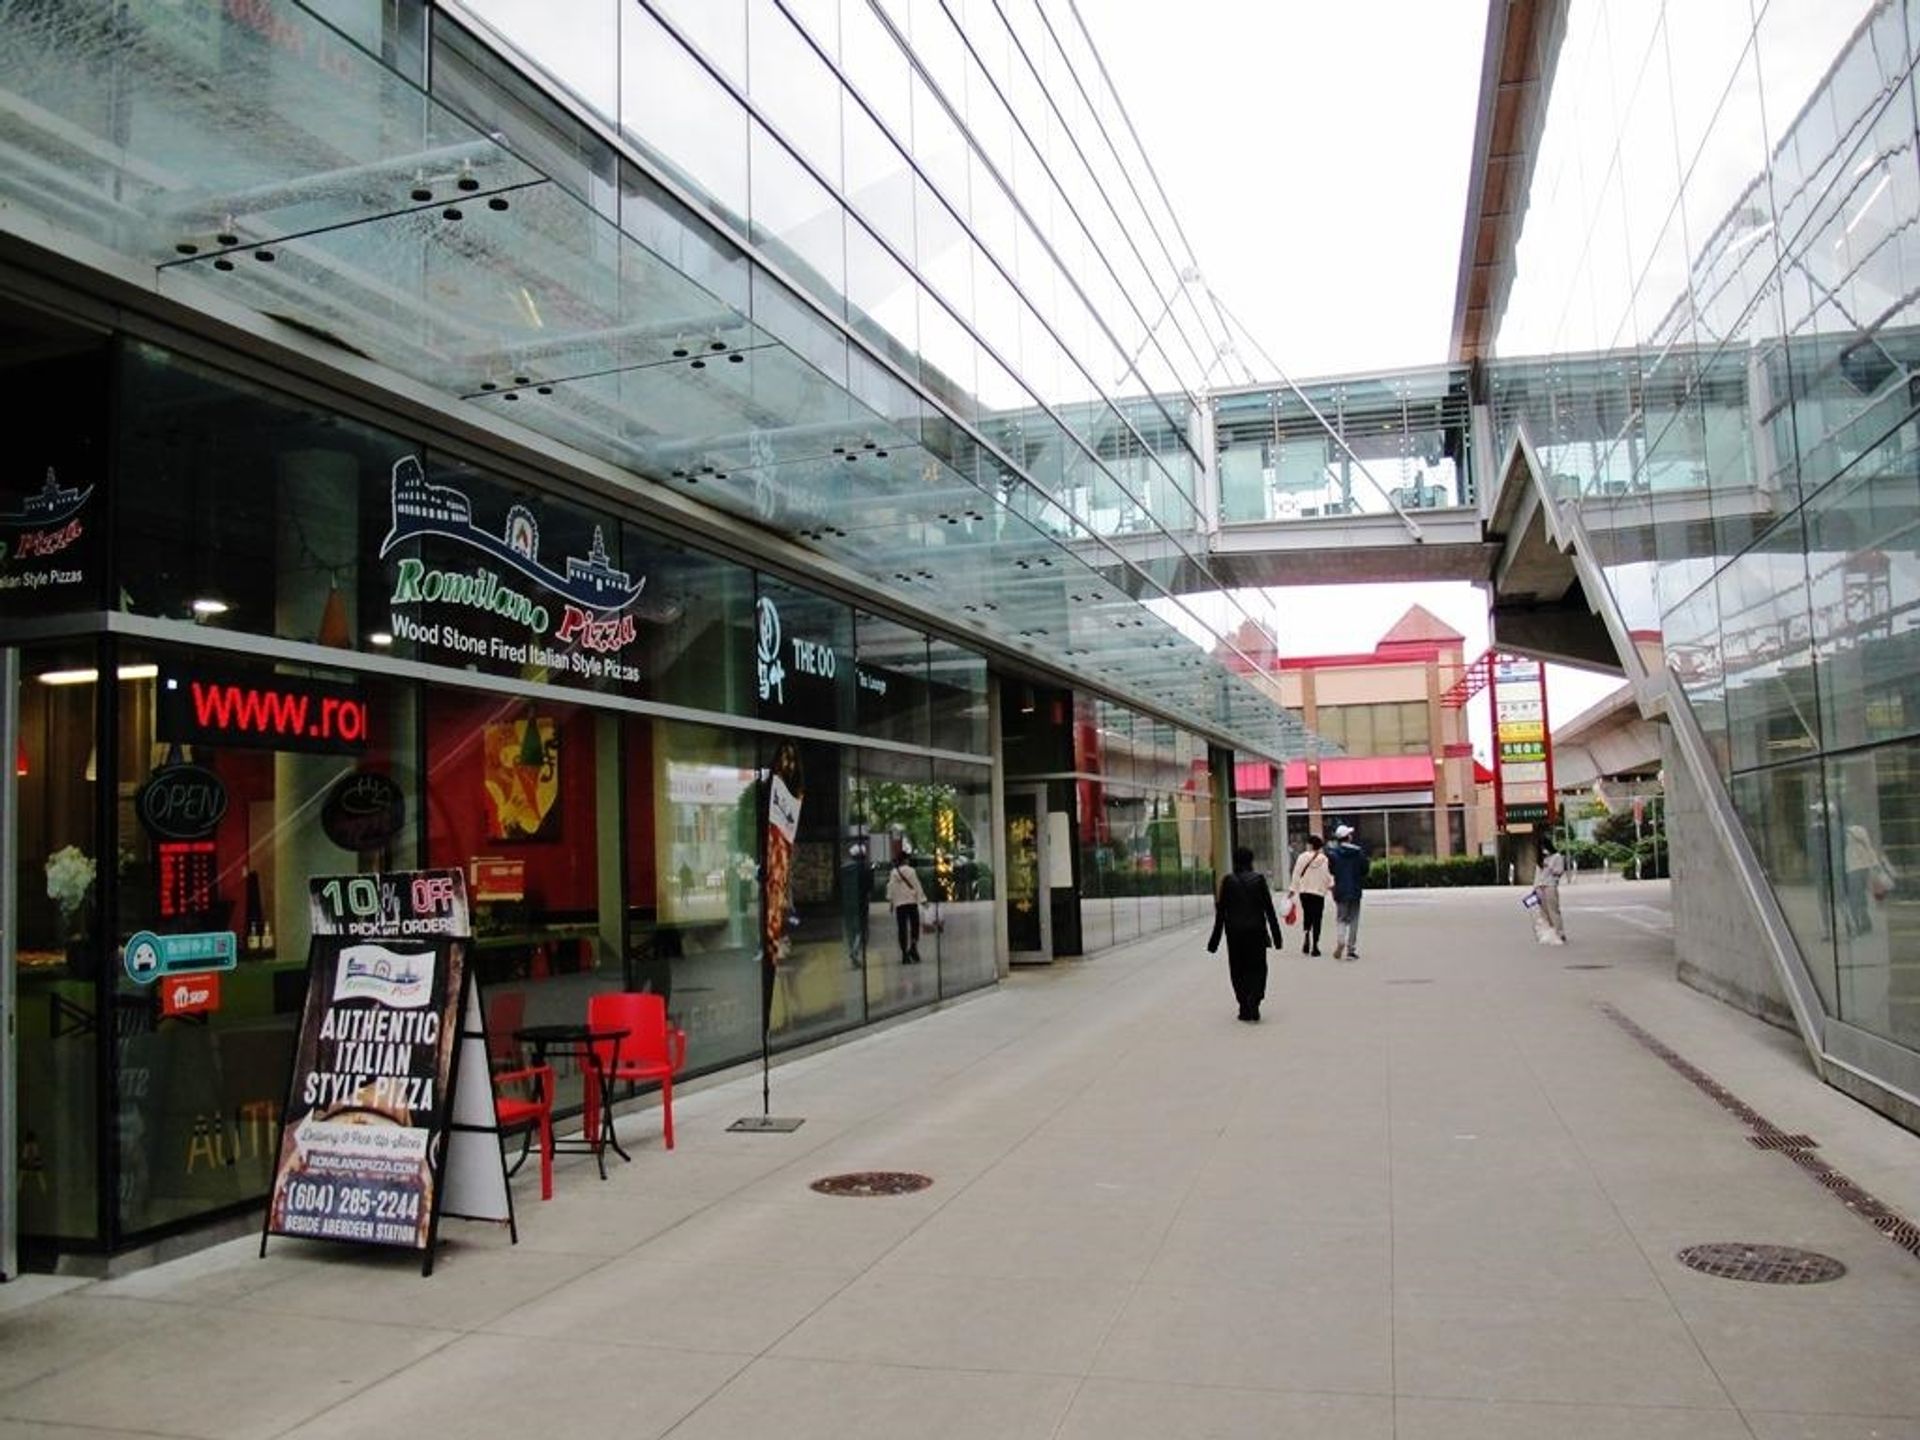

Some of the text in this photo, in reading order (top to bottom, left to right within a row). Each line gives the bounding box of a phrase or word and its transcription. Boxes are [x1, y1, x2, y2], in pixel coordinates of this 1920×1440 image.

[13, 519, 82, 558] Pizza
[23, 572, 48, 590] Style
[51, 569, 82, 583] Pizzas
[391, 558, 637, 652] Romilano Pizza
[391, 613, 439, 645] Wood
[443, 626, 488, 655] Stone
[491, 638, 526, 663] Fired
[530, 644, 569, 670] Italian
[572, 655, 600, 678] Style
[792, 638, 817, 675] THE
[191, 682, 366, 741] www.ro
[151, 784, 219, 820] OPEN
[412, 878, 452, 912] OFF
[349, 922, 379, 935] PICK
[319, 1008, 440, 1044] AUTHENTIC
[335, 1043, 412, 1075] ITALIAN
[304, 1072, 433, 1111] STYLE PIZZA
[287, 1182, 420, 1219] (604) 285-2244
[285, 1214, 417, 1241] BESIDE ABERDEEN STATION
